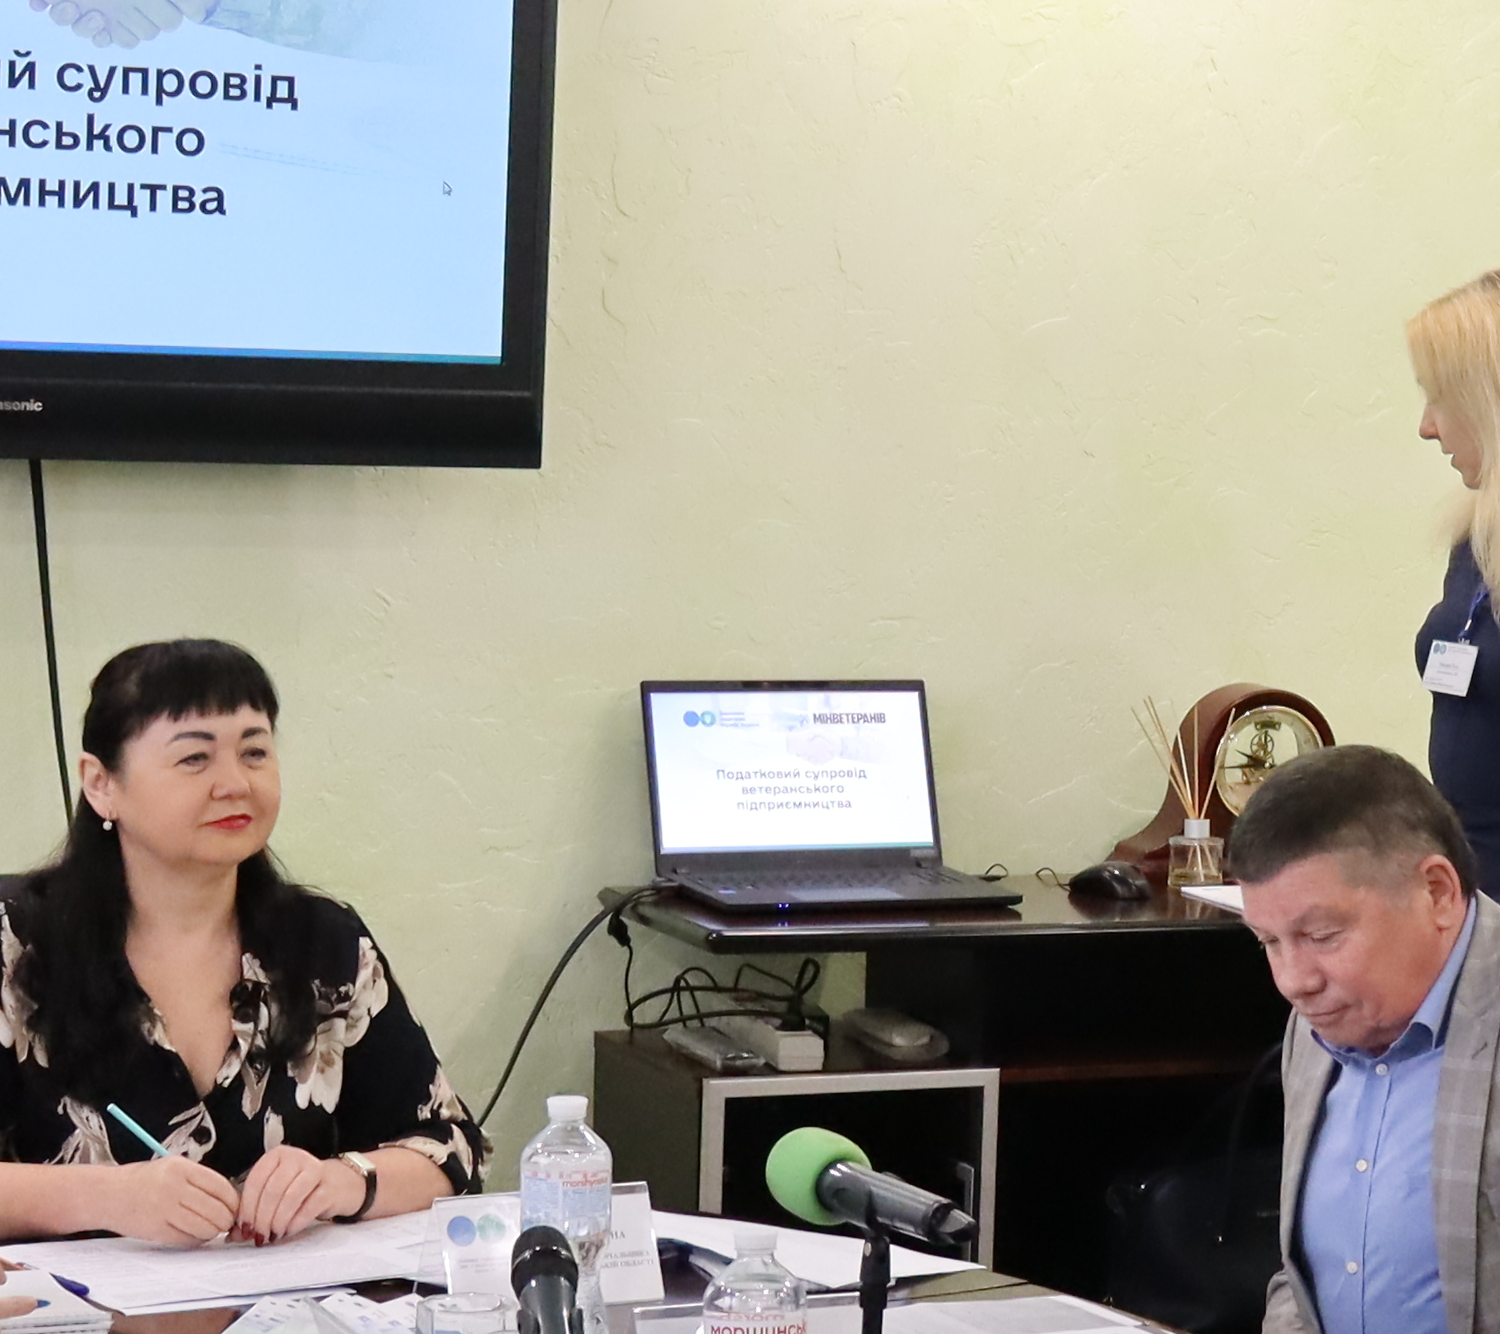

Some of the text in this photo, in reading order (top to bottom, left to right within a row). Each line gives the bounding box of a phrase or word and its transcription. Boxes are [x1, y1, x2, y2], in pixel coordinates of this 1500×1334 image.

[56, 64, 300, 111] супровід
[813, 713, 886, 725] МІНВЕТЕРАНІВ
[716, 768, 867, 781] Податковий супровід
[742, 784, 844, 796] ветеранського
[737, 799, 852, 811] підприємництва
